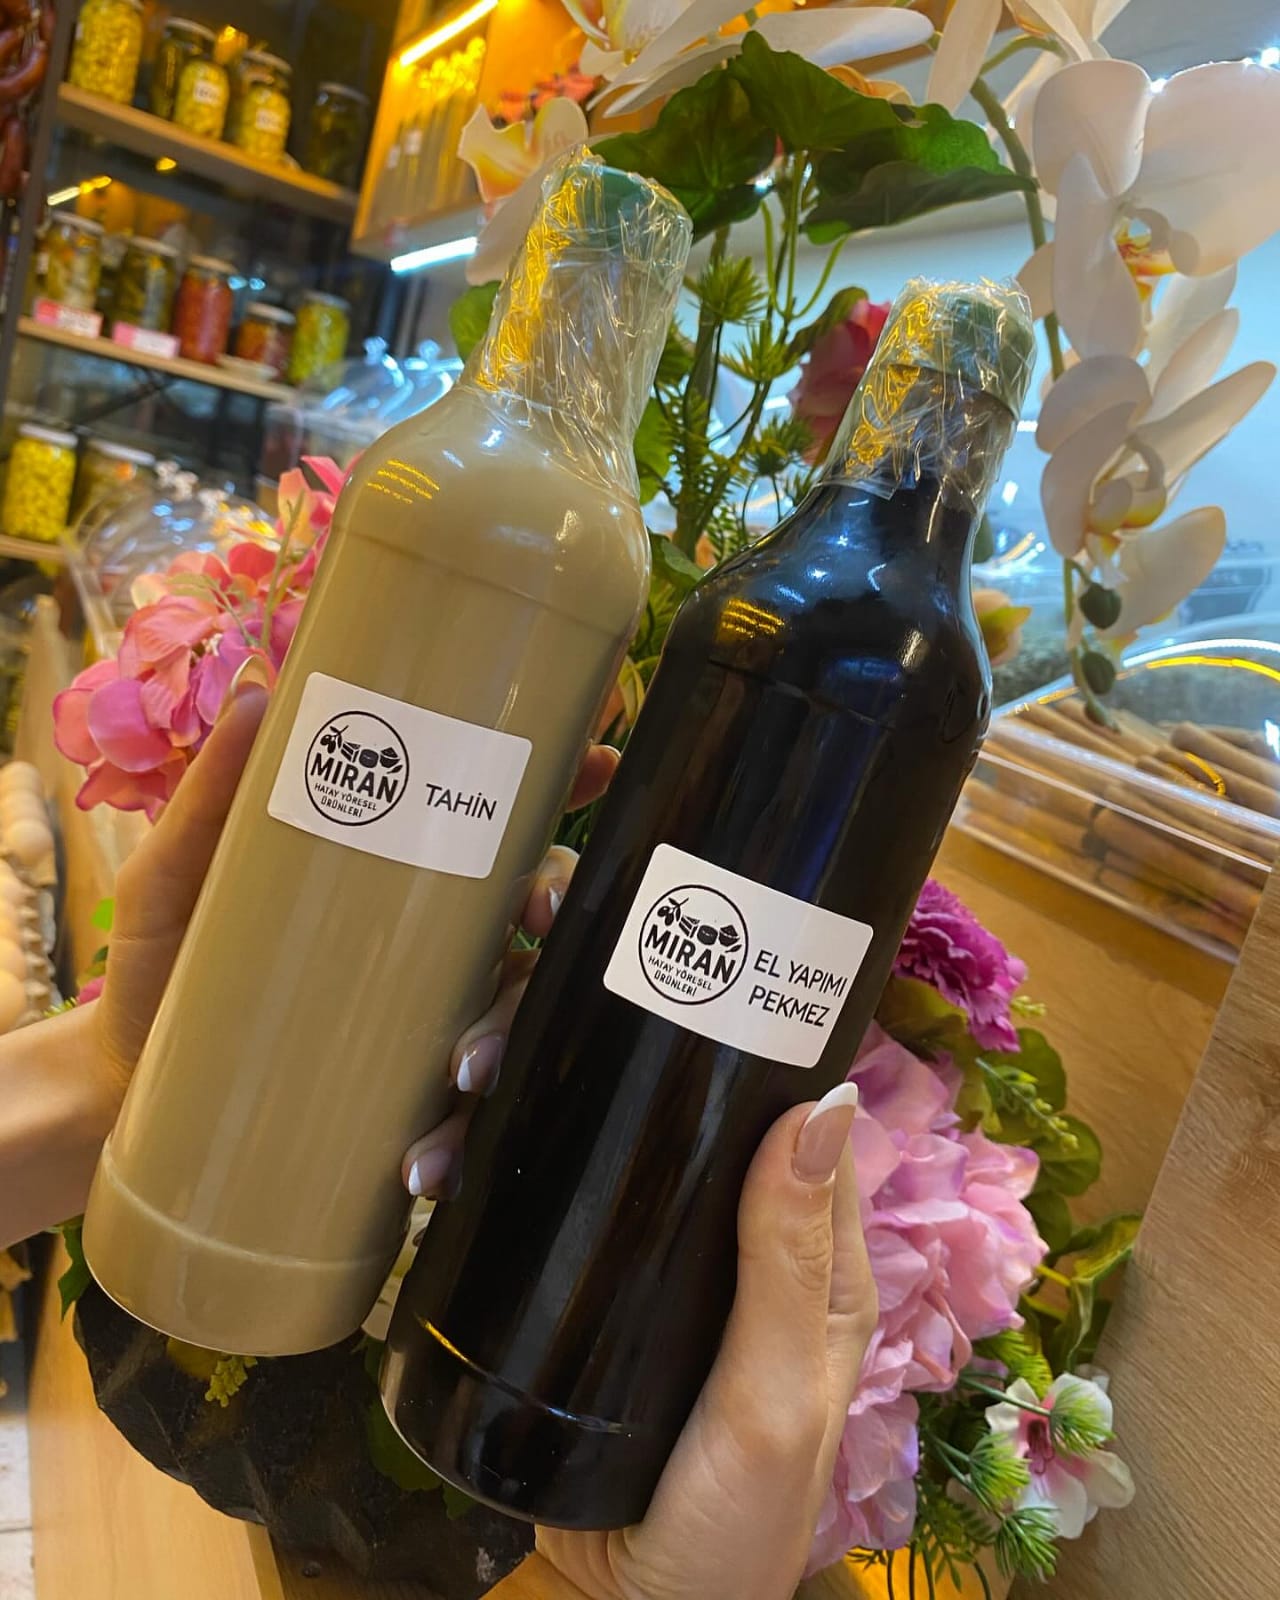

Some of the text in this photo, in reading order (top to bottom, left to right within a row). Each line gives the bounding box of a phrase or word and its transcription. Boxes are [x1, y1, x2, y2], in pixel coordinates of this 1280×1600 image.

[310, 753, 398, 803] MIRAN
[314, 783, 377, 811] HATAY YÖRESEL
[321, 797, 363, 818] ÜRÜNLERİ
[426, 783, 497, 820] TAHİN
[644, 924, 736, 984] MIRAN
[648, 956, 712, 991] HATAY YÖRESEL
[653, 972, 697, 997] ÜRÜNLERİ
[754, 950, 848, 997] EL YAPIMI
[748, 985, 831, 1027] PEKMEZ
